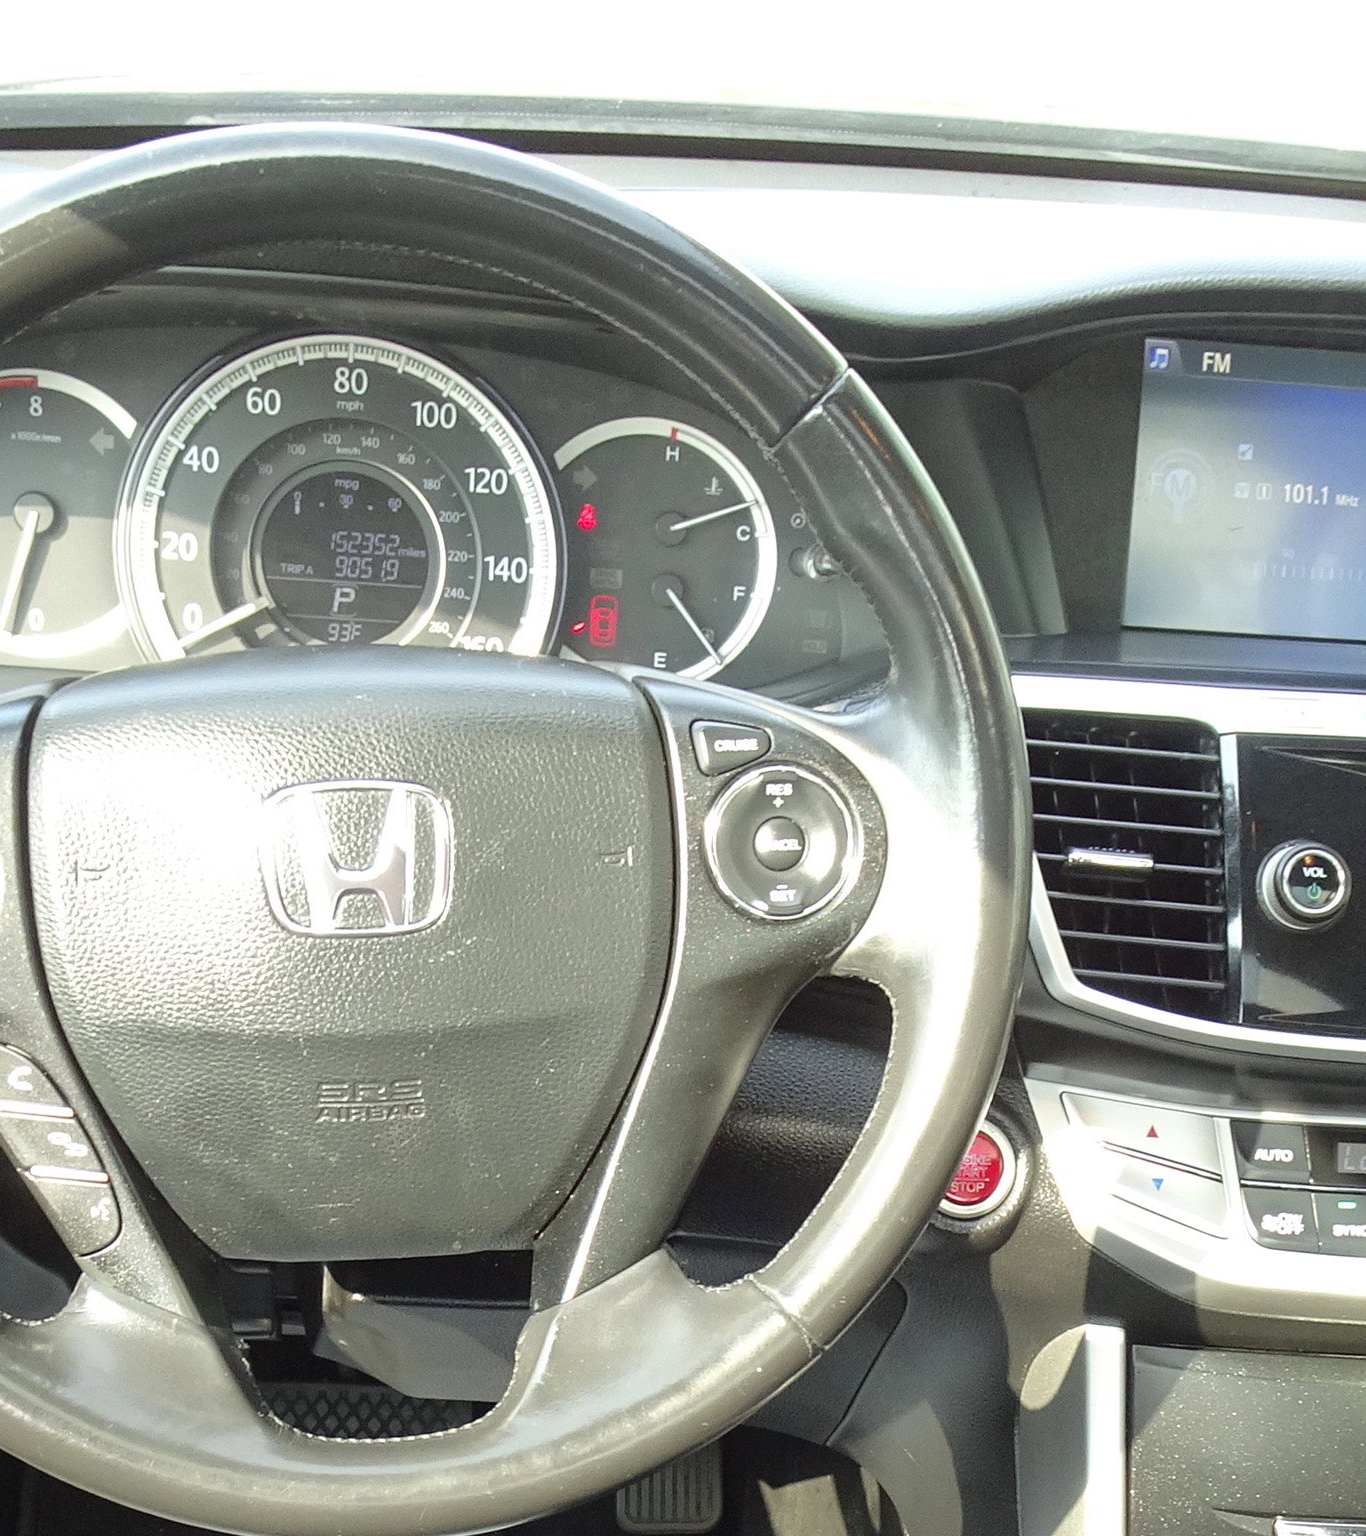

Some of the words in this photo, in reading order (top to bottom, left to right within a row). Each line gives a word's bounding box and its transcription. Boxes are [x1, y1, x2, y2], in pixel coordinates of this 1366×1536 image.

[1202, 352, 1232, 374] FM
[333, 366, 369, 396] 80
[29, 395, 44, 418] 8
[245, 386, 282, 416] 60
[336, 401, 364, 413] mph
[410, 400, 458, 430] 100
[322, 432, 341, 446] 120
[360, 436, 380, 449] 140
[287, 443, 306, 456] 100
[665, 446, 680, 462] H
[182, 444, 220, 474] 40
[396, 452, 416, 465] 160
[334, 478, 360, 491] mpg
[422, 478, 442, 491] 180
[464, 466, 509, 496] 120
[1283, 482, 1330, 506] 101.1
[1334, 493, 1362, 508] MHz
[439, 510, 460, 523] 200
[736, 525, 750, 541] C
[160, 530, 199, 562] 20
[330, 530, 401, 556] 152352
[397, 548, 427, 558] miles
[447, 550, 468, 563] 220
[280, 562, 304, 575] TRIP
[305, 565, 314, 575] A
[484, 555, 529, 584] 140
[333, 586, 356, 613] P
[443, 587, 465, 600] 240
[733, 585, 746, 602] F
[28, 607, 45, 632] 0
[182, 602, 204, 632] 0
[653, 652, 667, 669] E
[713, 737, 759, 752] CRUISE
[765, 782, 793, 797] RES
[1302, 866, 1328, 879] VOL
[769, 888, 797, 902] SET
[315, 1103, 427, 1124] AIRBAG
[962, 1155, 993, 1166] GINE
[1254, 1148, 1295, 1163] AUTO
[957, 1166, 989, 1179] TART
[950, 1181, 986, 1194] STOP
